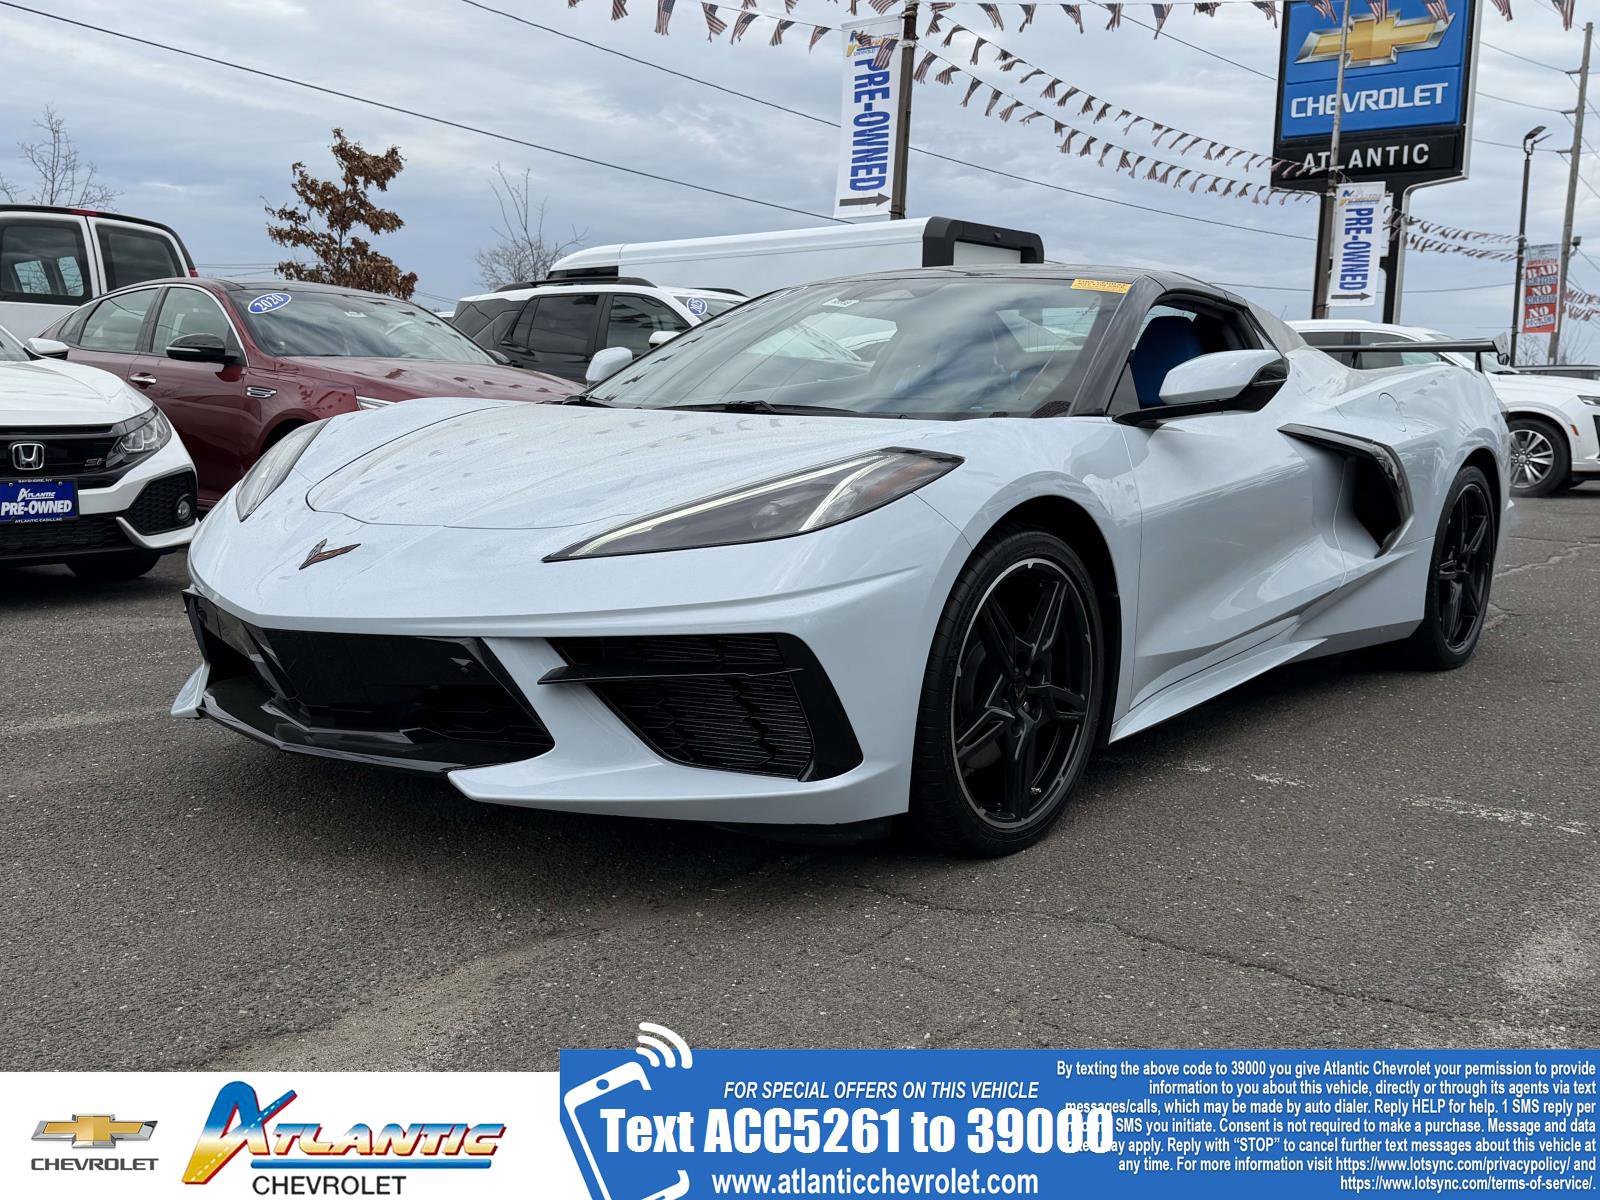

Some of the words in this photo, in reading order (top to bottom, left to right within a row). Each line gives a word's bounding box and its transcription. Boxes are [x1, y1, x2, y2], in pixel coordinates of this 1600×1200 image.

[1290, 82, 1449, 118] CHEVROLET
[850, 58, 890, 191] PRE-OWNED
[1338, 207, 1375, 291] PRE-OWNED
[1527, 264, 1558, 279] BAD
[1532, 284, 1552, 297] NO
[254, 293, 284, 312] 2020
[1529, 306, 1550, 319] NO
[1, 500, 72, 516] PRE-OWNED
